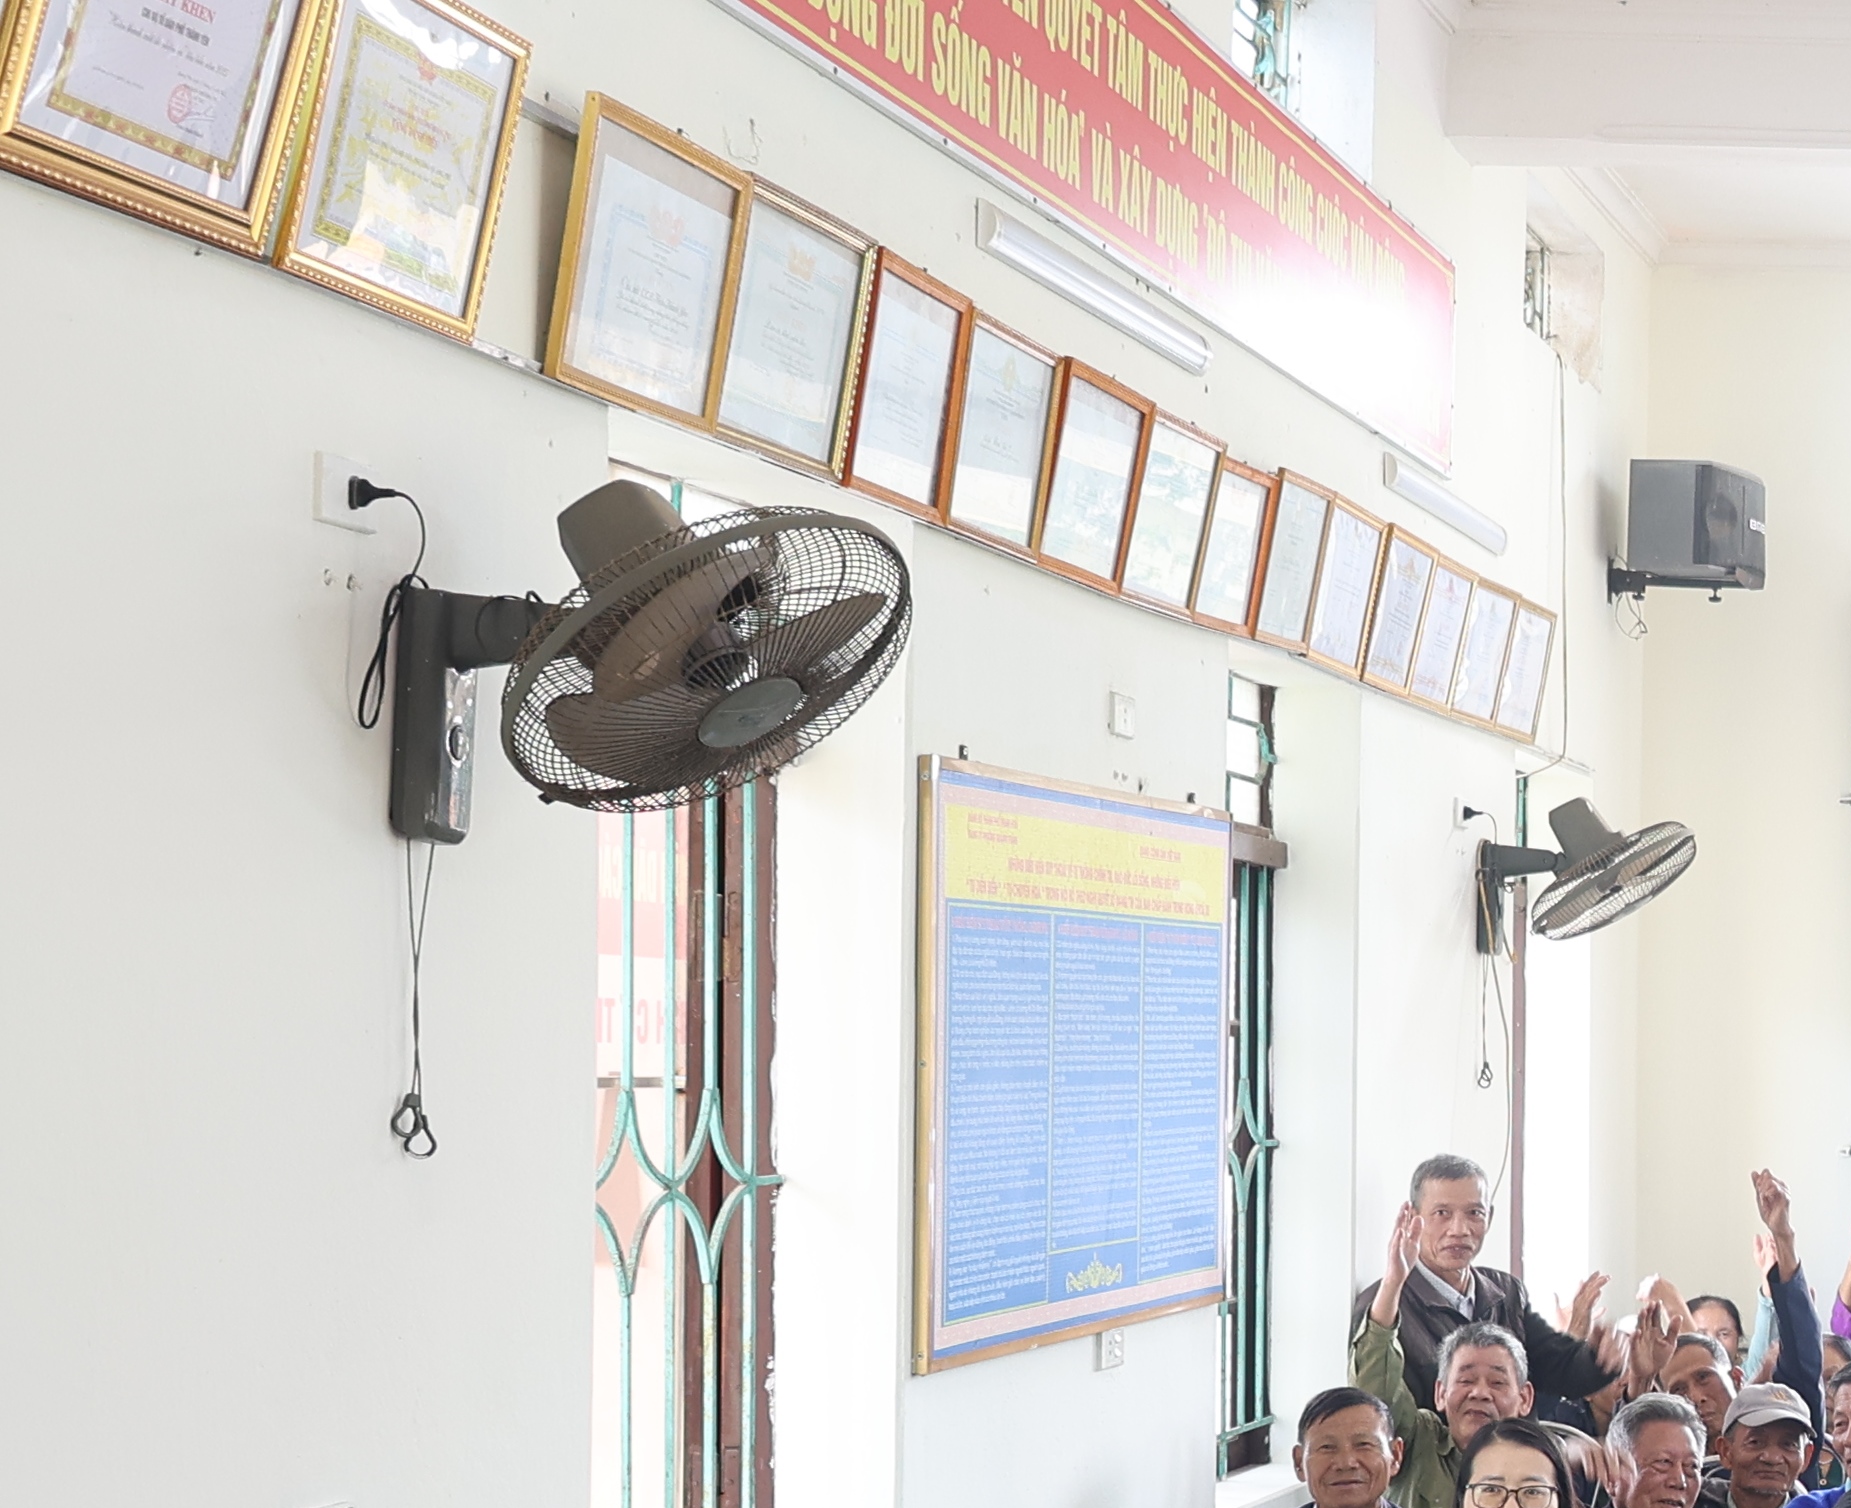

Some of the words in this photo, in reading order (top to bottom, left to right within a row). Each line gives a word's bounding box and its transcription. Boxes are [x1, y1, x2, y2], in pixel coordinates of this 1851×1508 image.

[931, 0, 991, 128] SỐNG
[997, 52, 1038, 160] VĂN
[1091, 122, 1113, 214] VÀ
[1118, 144, 1152, 238] XÂY
[1106, 8, 1144, 112] TÂM
[1148, 48, 1188, 153] THỰC
[1192, 86, 1228, 182] HIỆN
[1231, 121, 1276, 217] THÀNH
[1278, 156, 1313, 246] CÔNG
